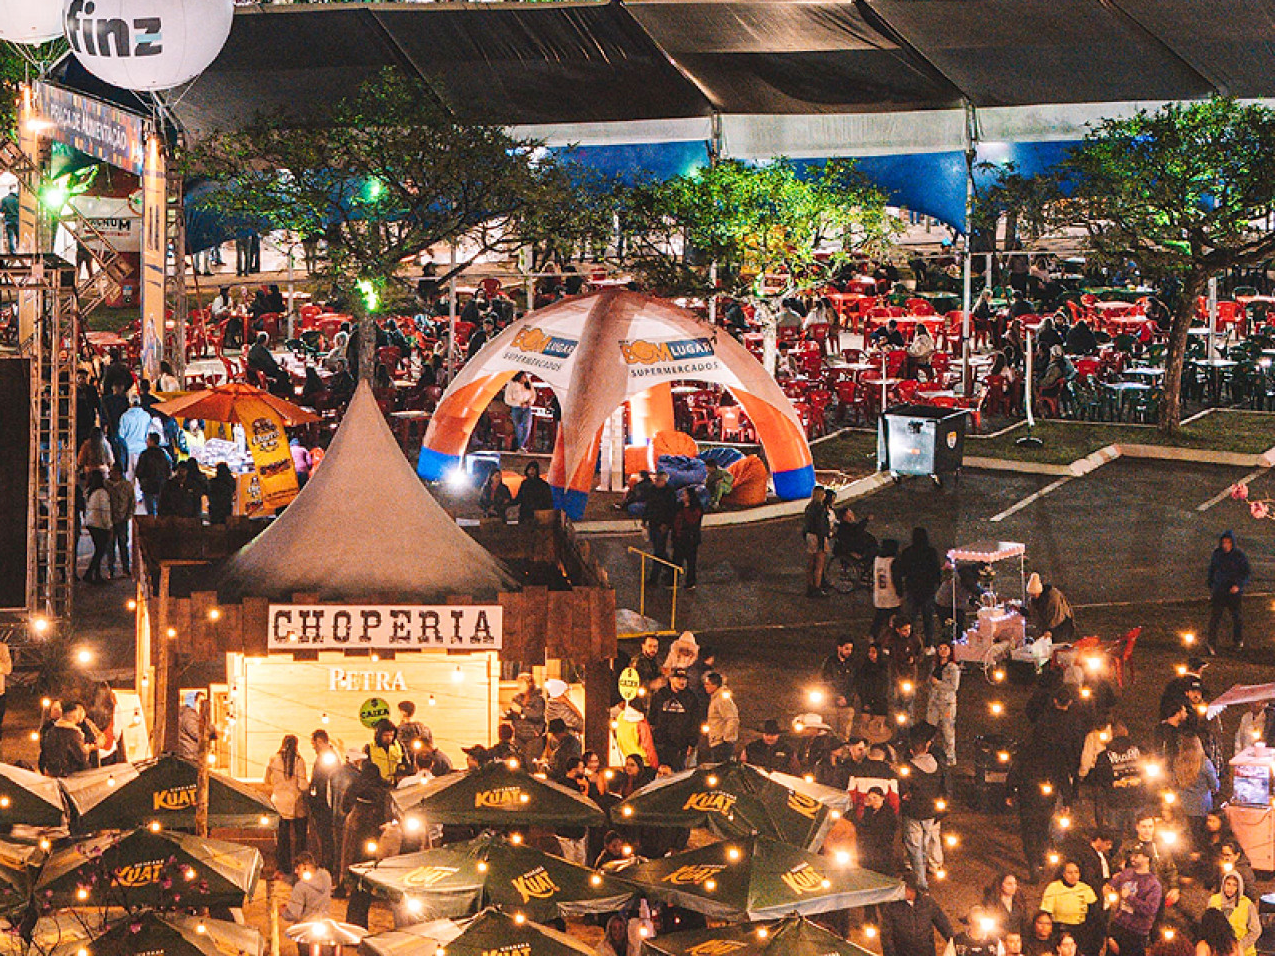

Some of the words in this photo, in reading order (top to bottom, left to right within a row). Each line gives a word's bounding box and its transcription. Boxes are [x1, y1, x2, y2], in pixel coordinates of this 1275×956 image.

[510, 327, 551, 353] BOM
[545, 341, 576, 354] LUGAR
[620, 340, 674, 365] BOM
[671, 341, 714, 357] LUGAR
[503, 351, 562, 372] SUPERMERCADOS
[630, 361, 719, 378] SUPERMERCADOS
[273, 610, 496, 644] CHOPERIA
[329, 667, 408, 691] PETRA
[152, 789, 197, 811] KUAT
[474, 789, 522, 809] KUAT
[511, 869, 561, 905] KUAT
